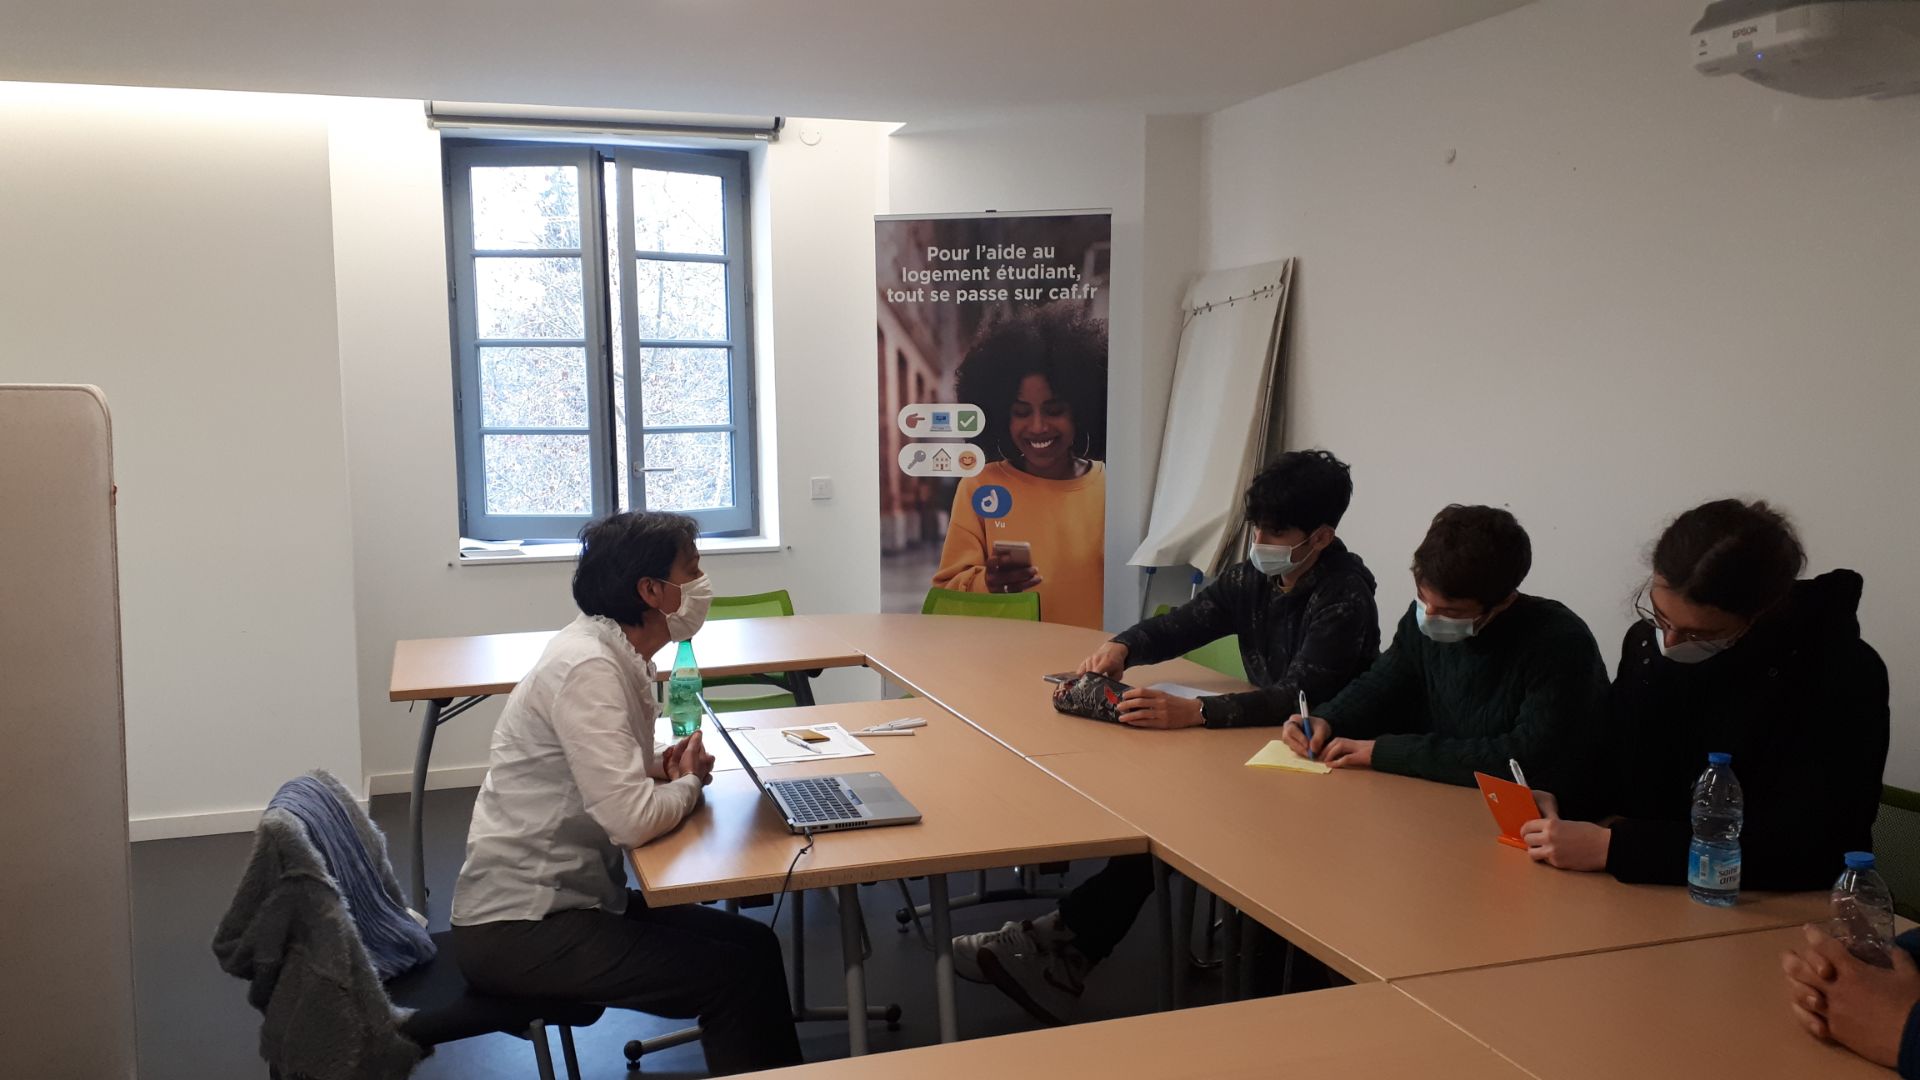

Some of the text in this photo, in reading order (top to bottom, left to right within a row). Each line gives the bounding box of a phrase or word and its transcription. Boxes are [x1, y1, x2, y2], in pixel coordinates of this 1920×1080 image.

[1732, 26, 1757, 38] EPSON
[927, 244, 1055, 261] Pour l’aide au
[902, 264, 1081, 284] logement étudiant,
[887, 283, 1098, 304] tout se passe sur caf.fr
[994, 520, 1006, 528] Vu
